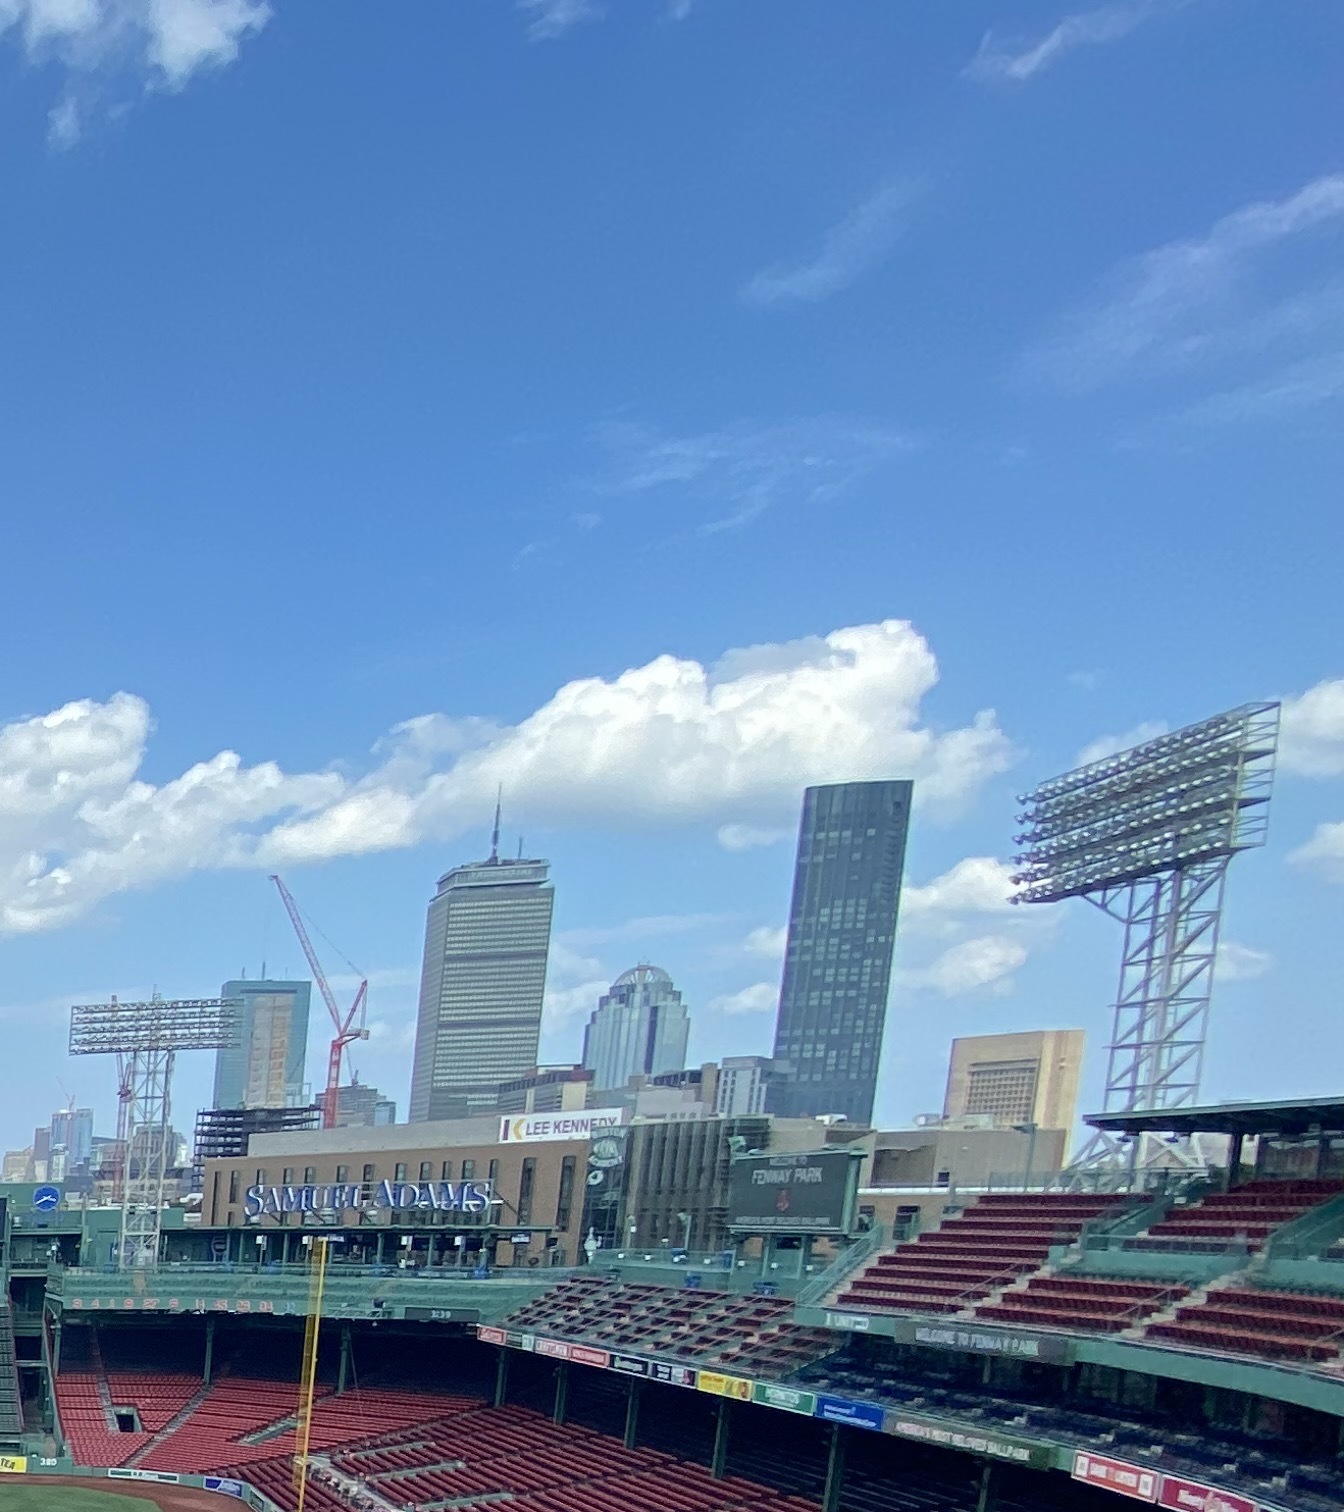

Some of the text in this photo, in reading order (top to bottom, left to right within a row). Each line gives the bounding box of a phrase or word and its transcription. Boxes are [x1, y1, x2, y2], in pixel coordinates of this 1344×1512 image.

[526, 1117, 617, 1136] LEE KENNEDY
[752, 1167, 823, 1184] FENWAY PARK
[244, 1179, 490, 1216] SAMUEL ADAMS
[0, 1457, 16, 1470] TEA
[40, 1458, 57, 1466] 380
